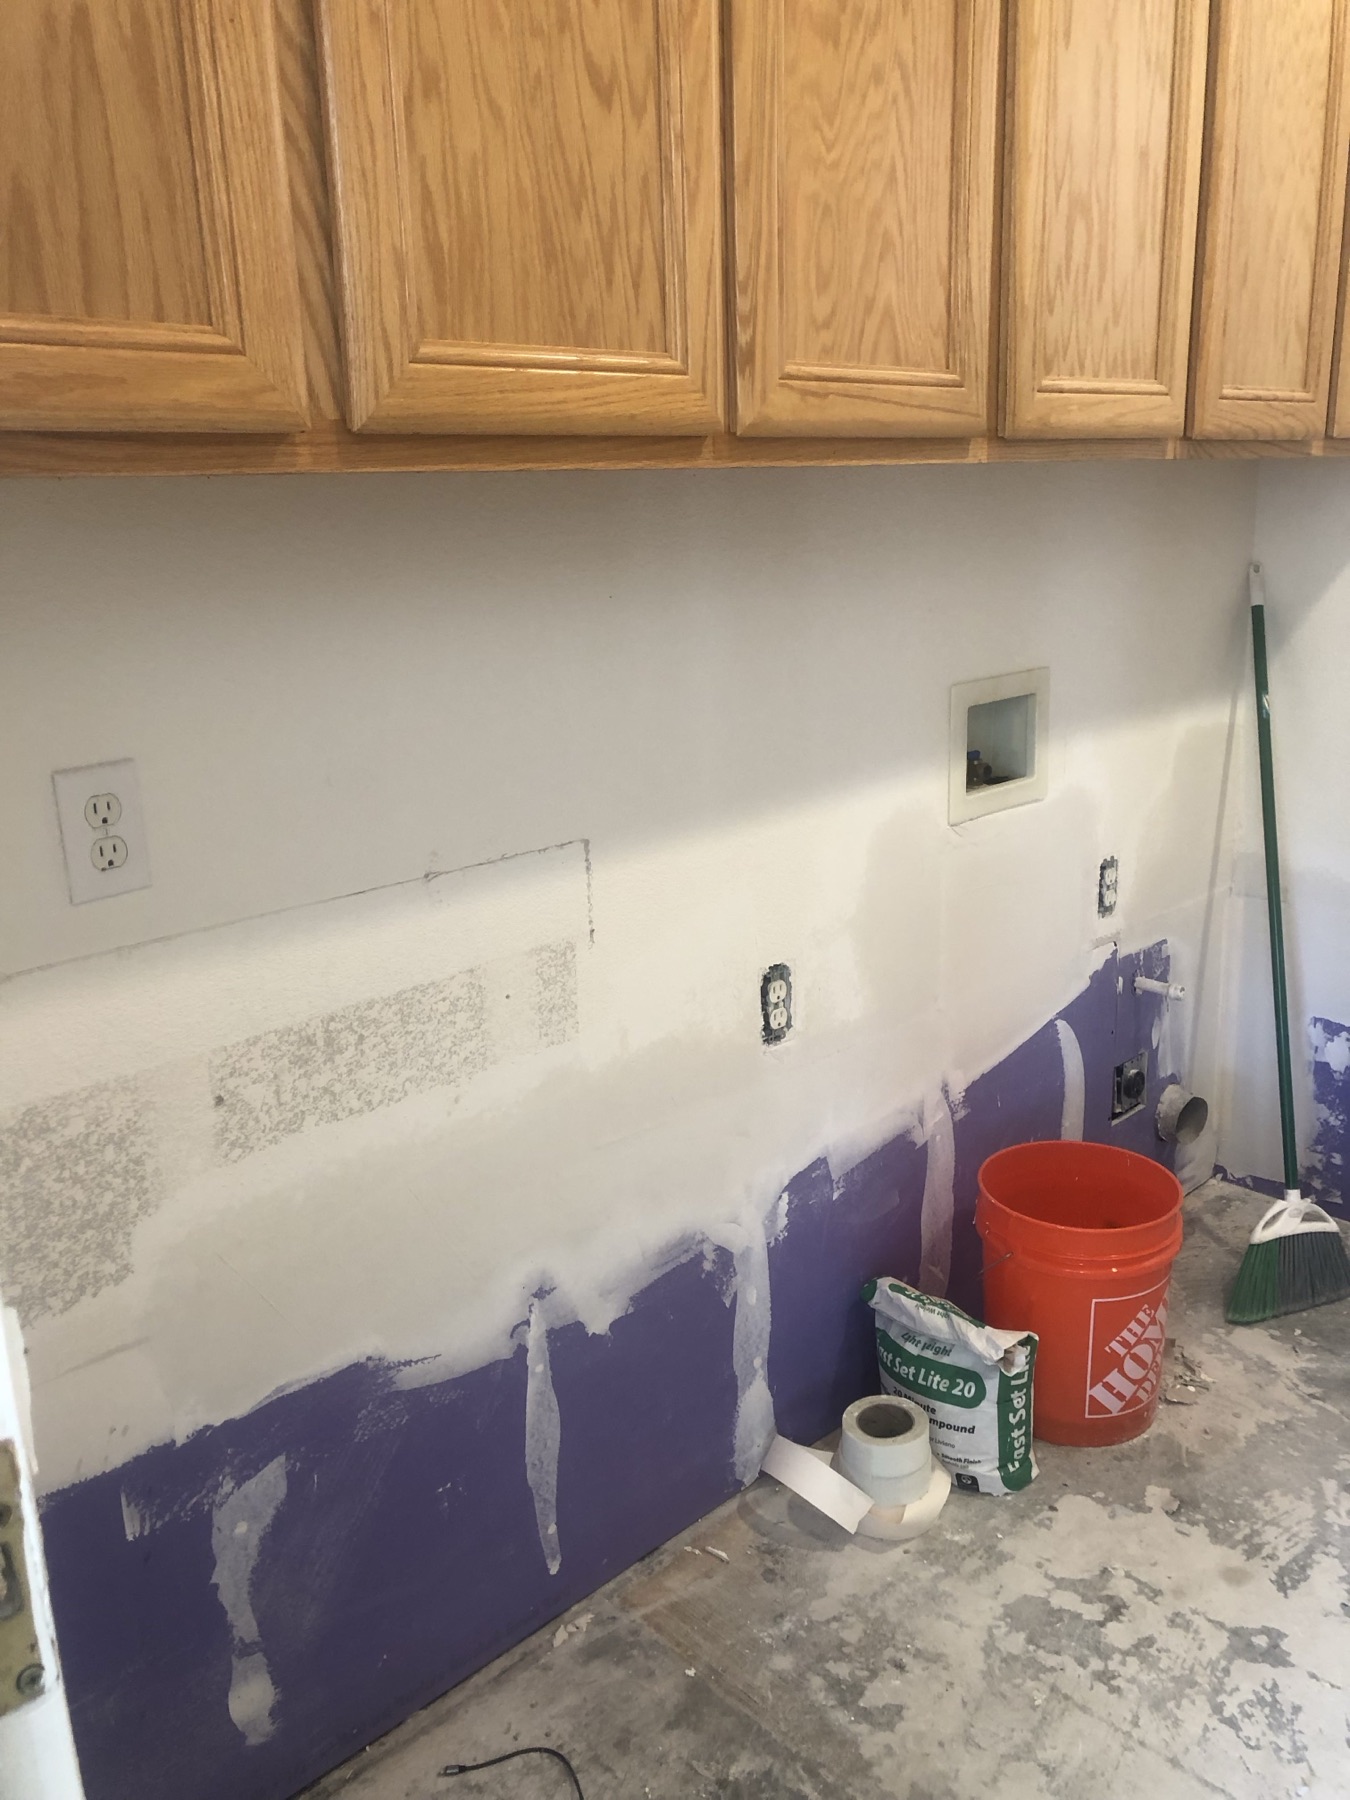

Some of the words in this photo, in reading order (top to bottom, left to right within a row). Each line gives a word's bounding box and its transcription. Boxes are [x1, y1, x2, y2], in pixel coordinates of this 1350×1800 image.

[1104, 1304, 1155, 1357] THE
[893, 1357, 916, 1381] Set
[917, 1368, 950, 1392] Lite
[951, 1378, 976, 1398] 20
[929, 1416, 976, 1434] mpound
[1008, 1388, 1027, 1426] Set
[1007, 1425, 1026, 1473] Fast
